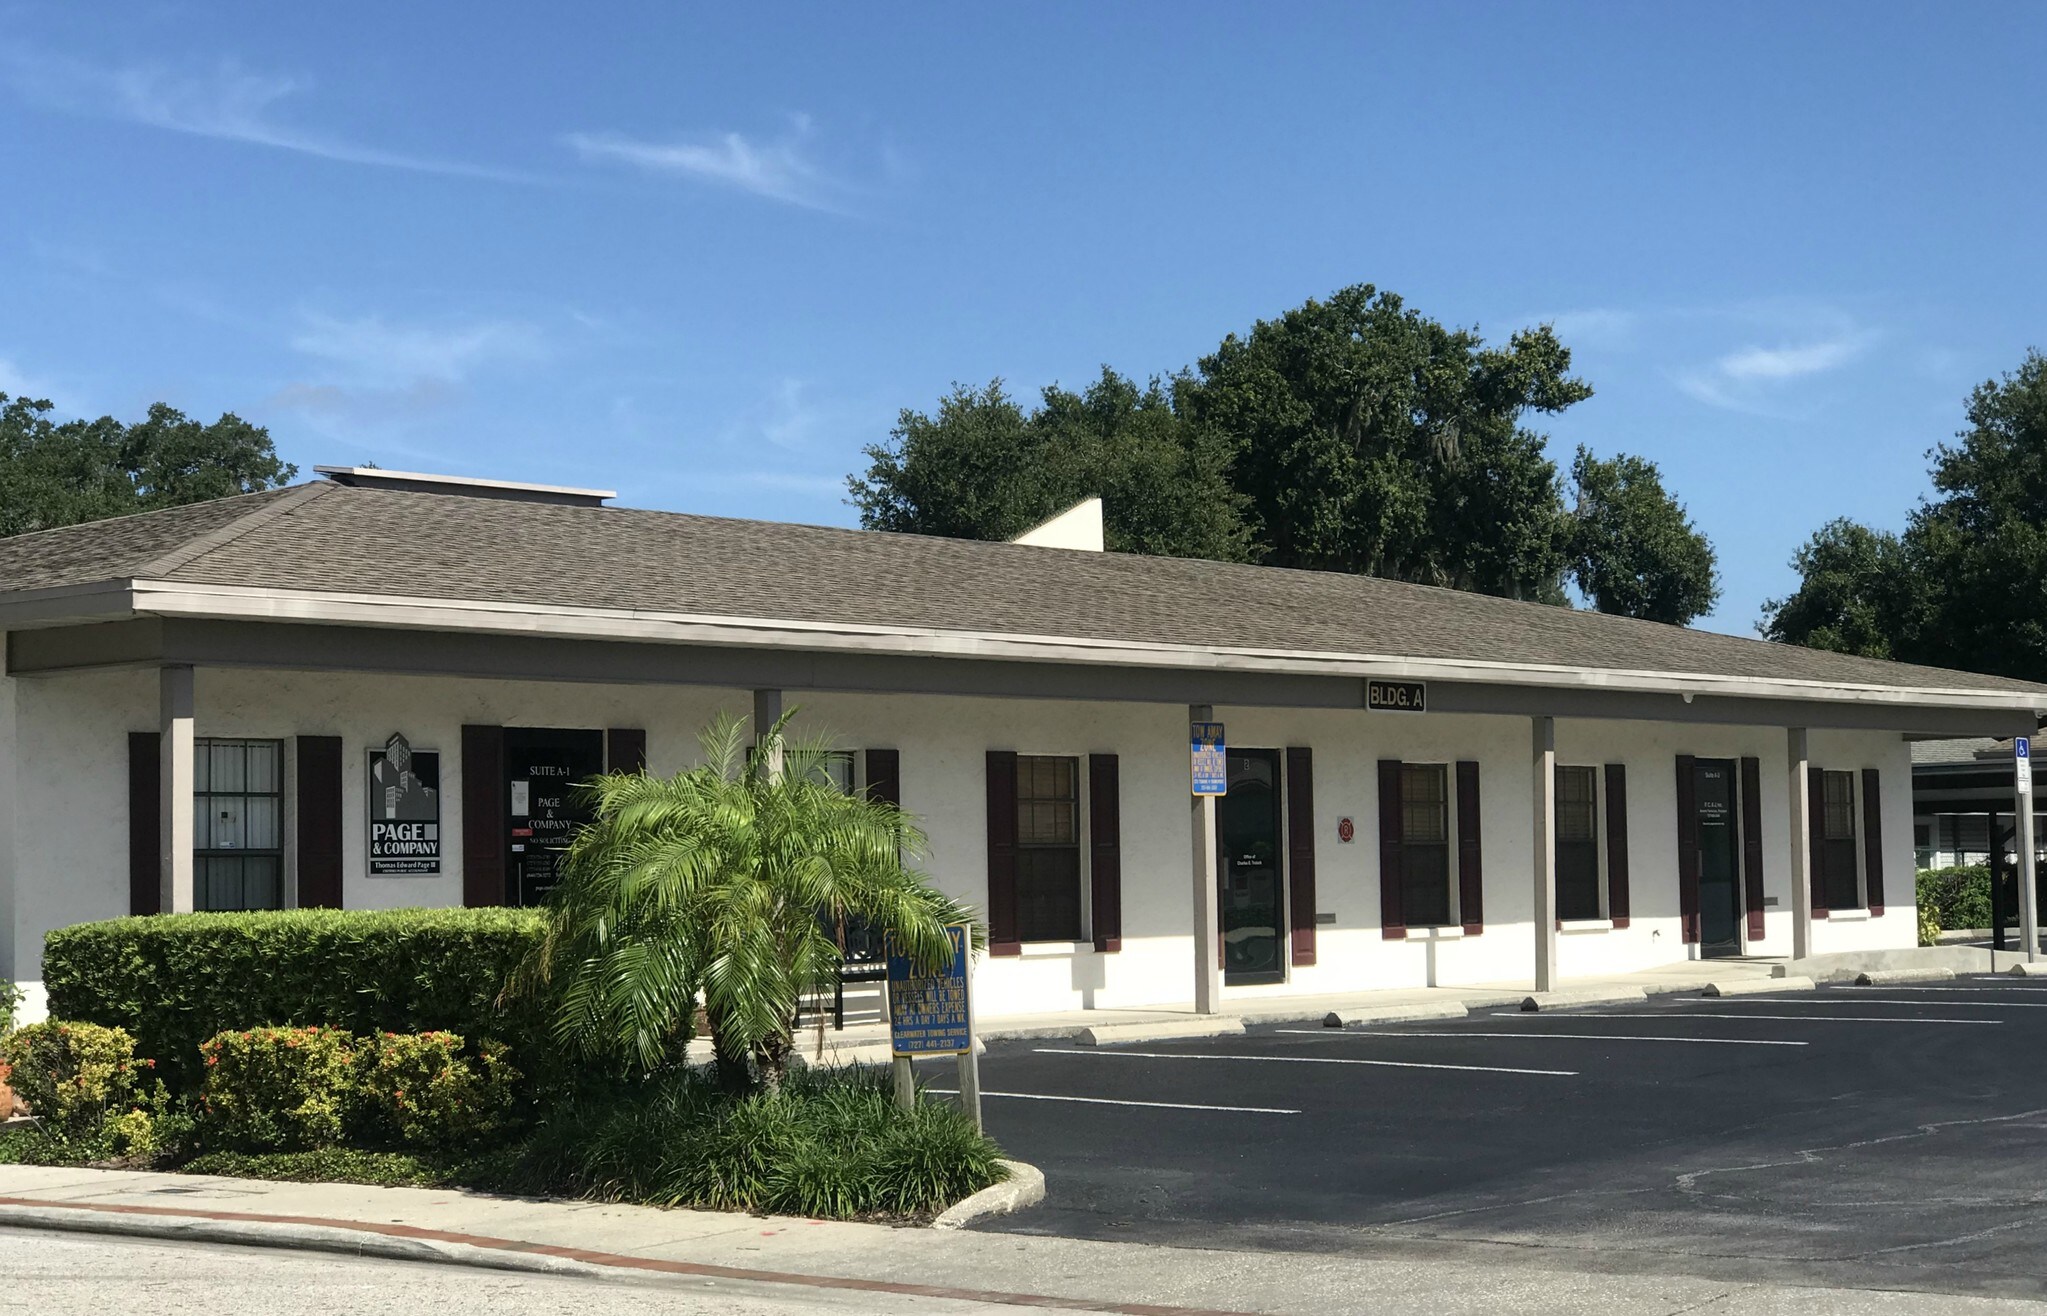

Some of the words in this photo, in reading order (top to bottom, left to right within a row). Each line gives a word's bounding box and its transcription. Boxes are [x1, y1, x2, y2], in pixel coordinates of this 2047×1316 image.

[1371, 686, 1410, 706] BLDG.
[1413, 688, 1423, 707] A
[1192, 725, 1205, 738] TOW
[1208, 725, 1223, 738] AWAY
[530, 766, 555, 776] SUITE
[557, 767, 570, 776] A-1
[538, 798, 560, 808] PAGE
[546, 809, 554, 818] &
[528, 820, 572, 829] COMPANY
[372, 823, 424, 841] PAGE
[540, 836, 571, 844] SOLICITING
[372, 842, 382, 855] &
[384, 842, 438, 855] COMPANY
[417, 862, 430, 870] Page
[937, 976, 965, 991] VEHICLES
[892, 992, 900, 1004] OR
[901, 990, 924, 1003] VESSELS
[925, 989, 937, 1002] WILL
[939, 989, 946, 1001] BE
[947, 988, 965, 1001] TOWED
[917, 1001, 941, 1015] OWNERS
[942, 1000, 965, 1014] EXPENSE
[894, 1015, 902, 1026] 24
[903, 1015, 913, 1026] HRS
[915, 1014, 920, 1025] A
[921, 1014, 930, 1025] DAY
[932, 1014, 936, 1024] 7
[937, 1013, 950, 1024] DAYS
[951, 1013, 956, 1023] A
[894, 1030, 926, 1039] CLEARWATER
[927, 1029, 946, 1037] TOWING
[947, 1028, 967, 1037] SERVICE
[908, 1040, 924, 1049] (727)
